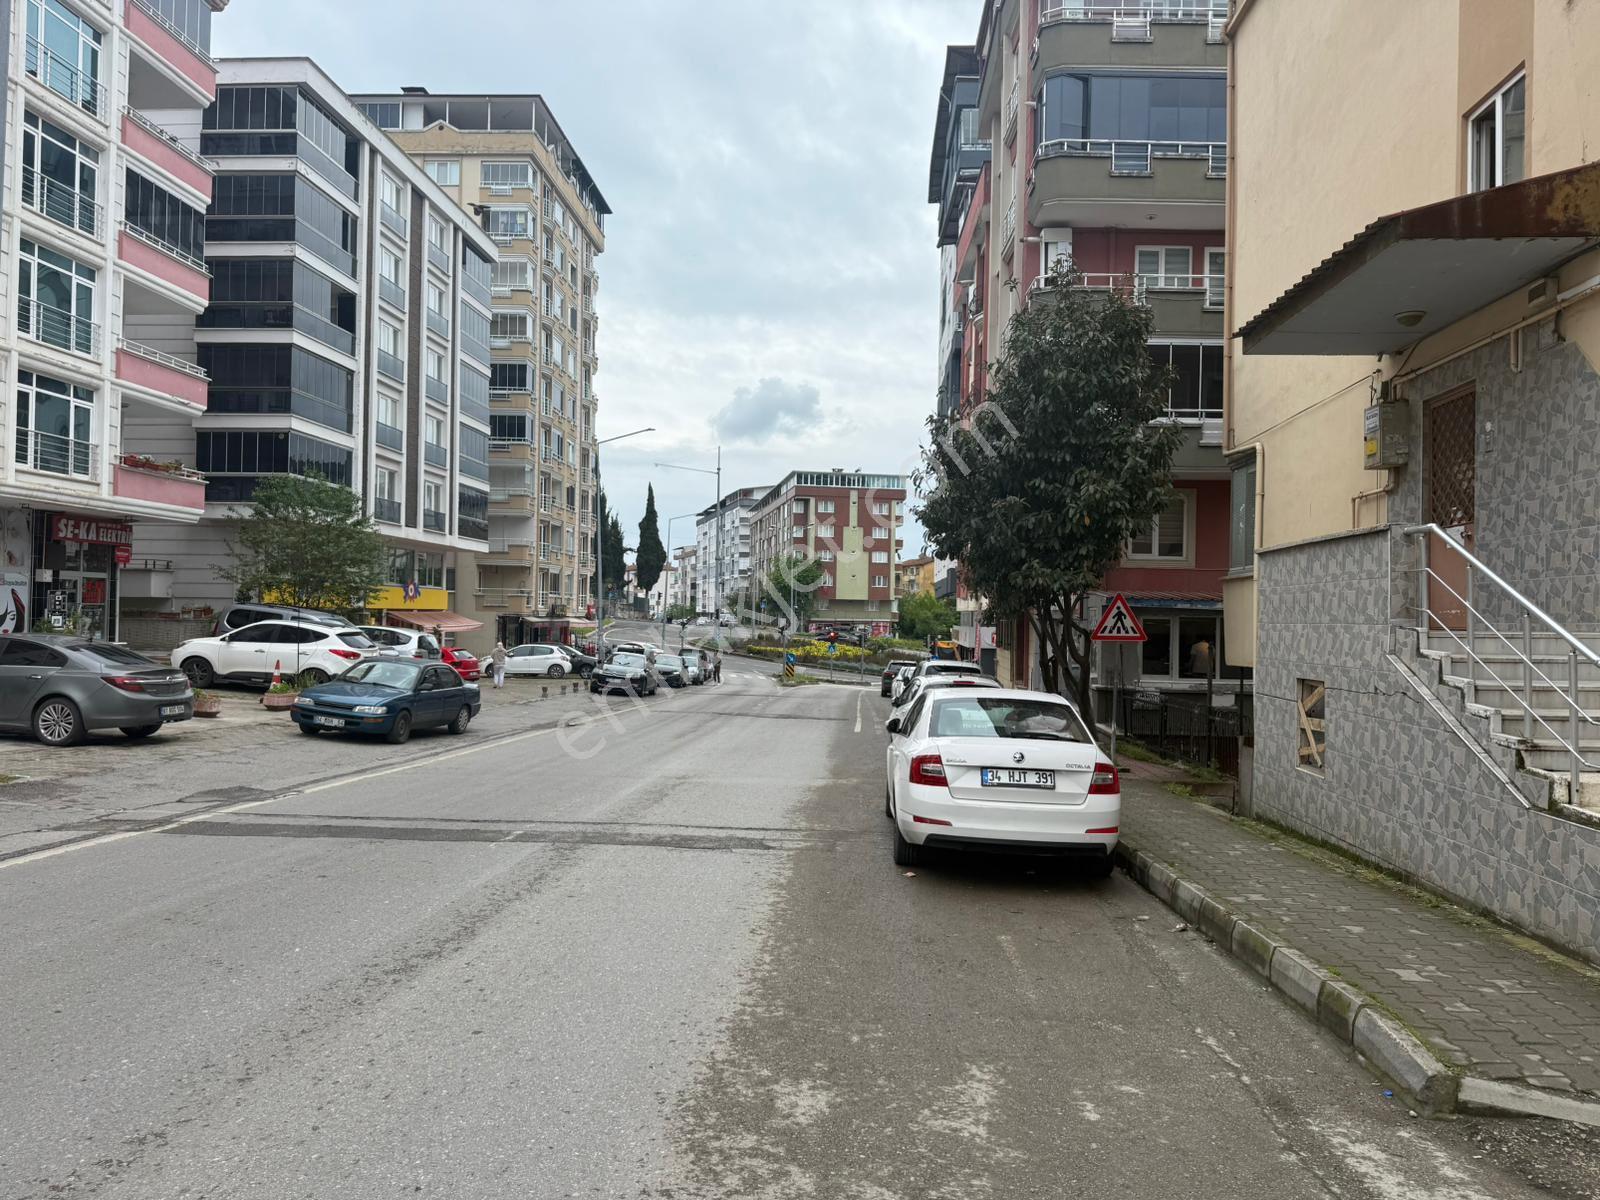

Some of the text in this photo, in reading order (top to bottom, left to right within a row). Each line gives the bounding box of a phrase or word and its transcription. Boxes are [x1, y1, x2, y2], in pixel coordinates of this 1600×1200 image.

[58, 518, 97, 540] SE-KA
[988, 770, 1053, 784] 34 HJT 391
